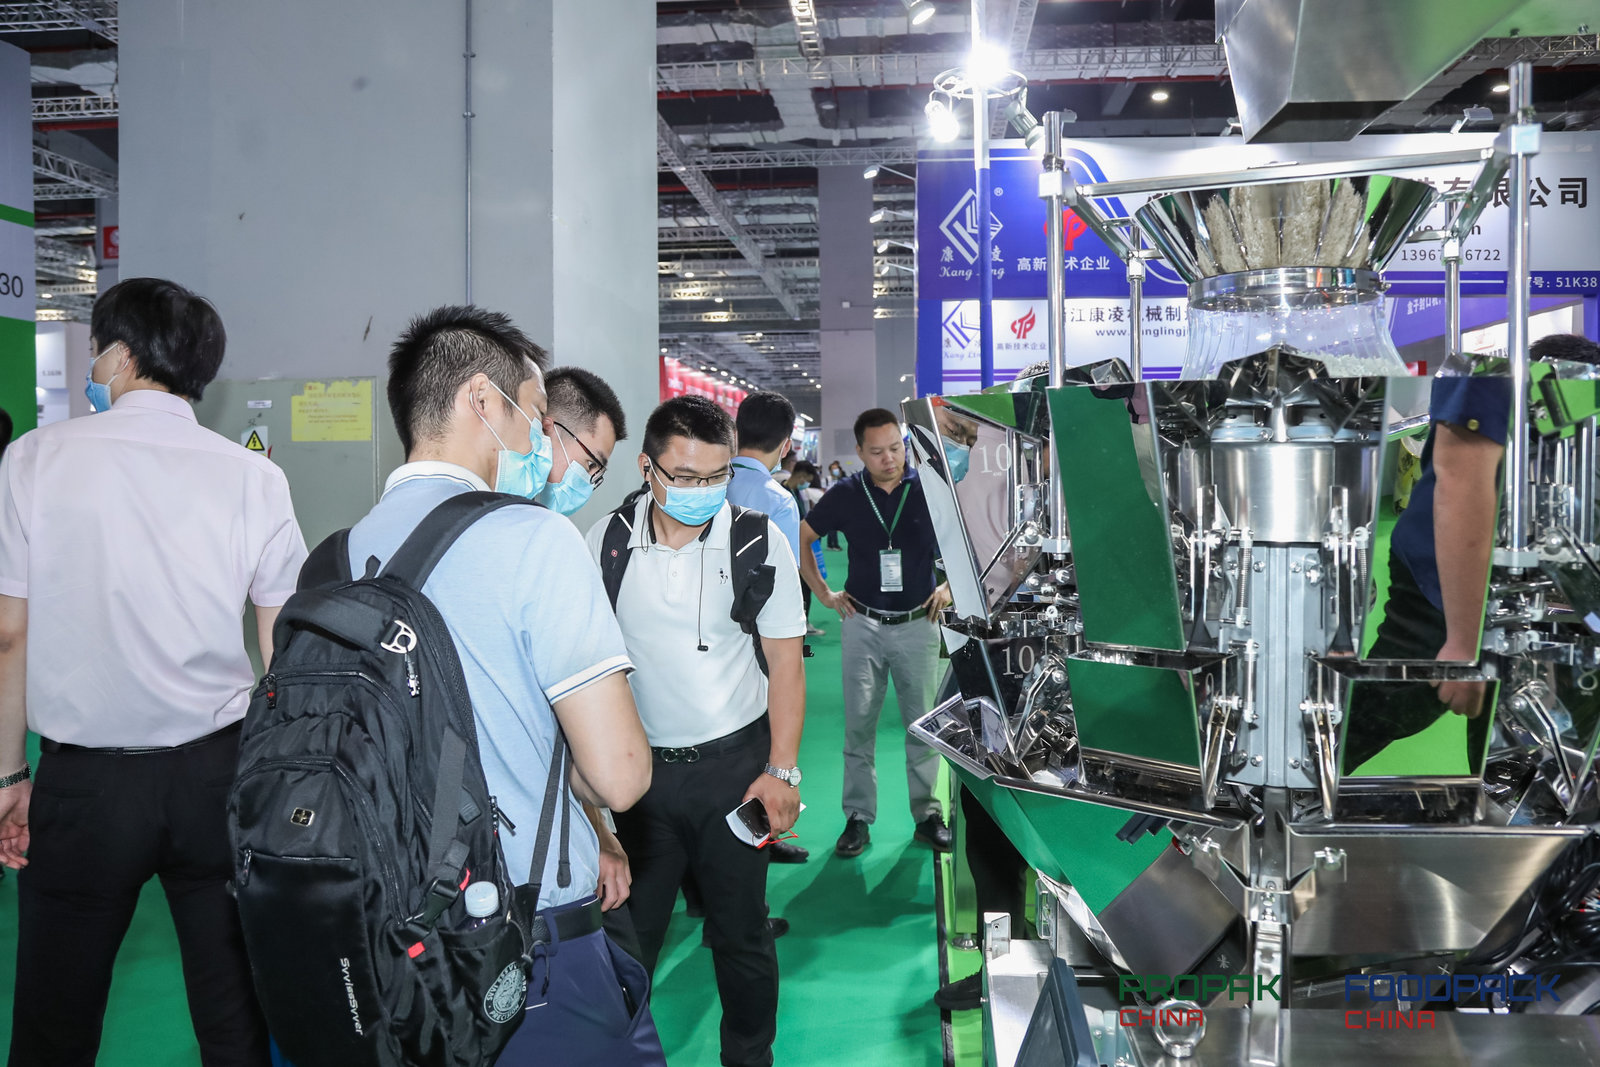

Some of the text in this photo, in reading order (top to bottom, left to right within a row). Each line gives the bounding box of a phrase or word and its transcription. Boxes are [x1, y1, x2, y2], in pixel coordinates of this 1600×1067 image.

[1401, 249, 1500, 261] 13966722
[1017, 256, 1111, 272] 高新术企业
[939, 266, 974, 281] Kang
[1555, 276, 1598, 288] 51K38
[1063, 305, 1188, 323] 江康凌械制
[979, 443, 1012, 473] 10
[1002, 644, 1035, 676] 10
